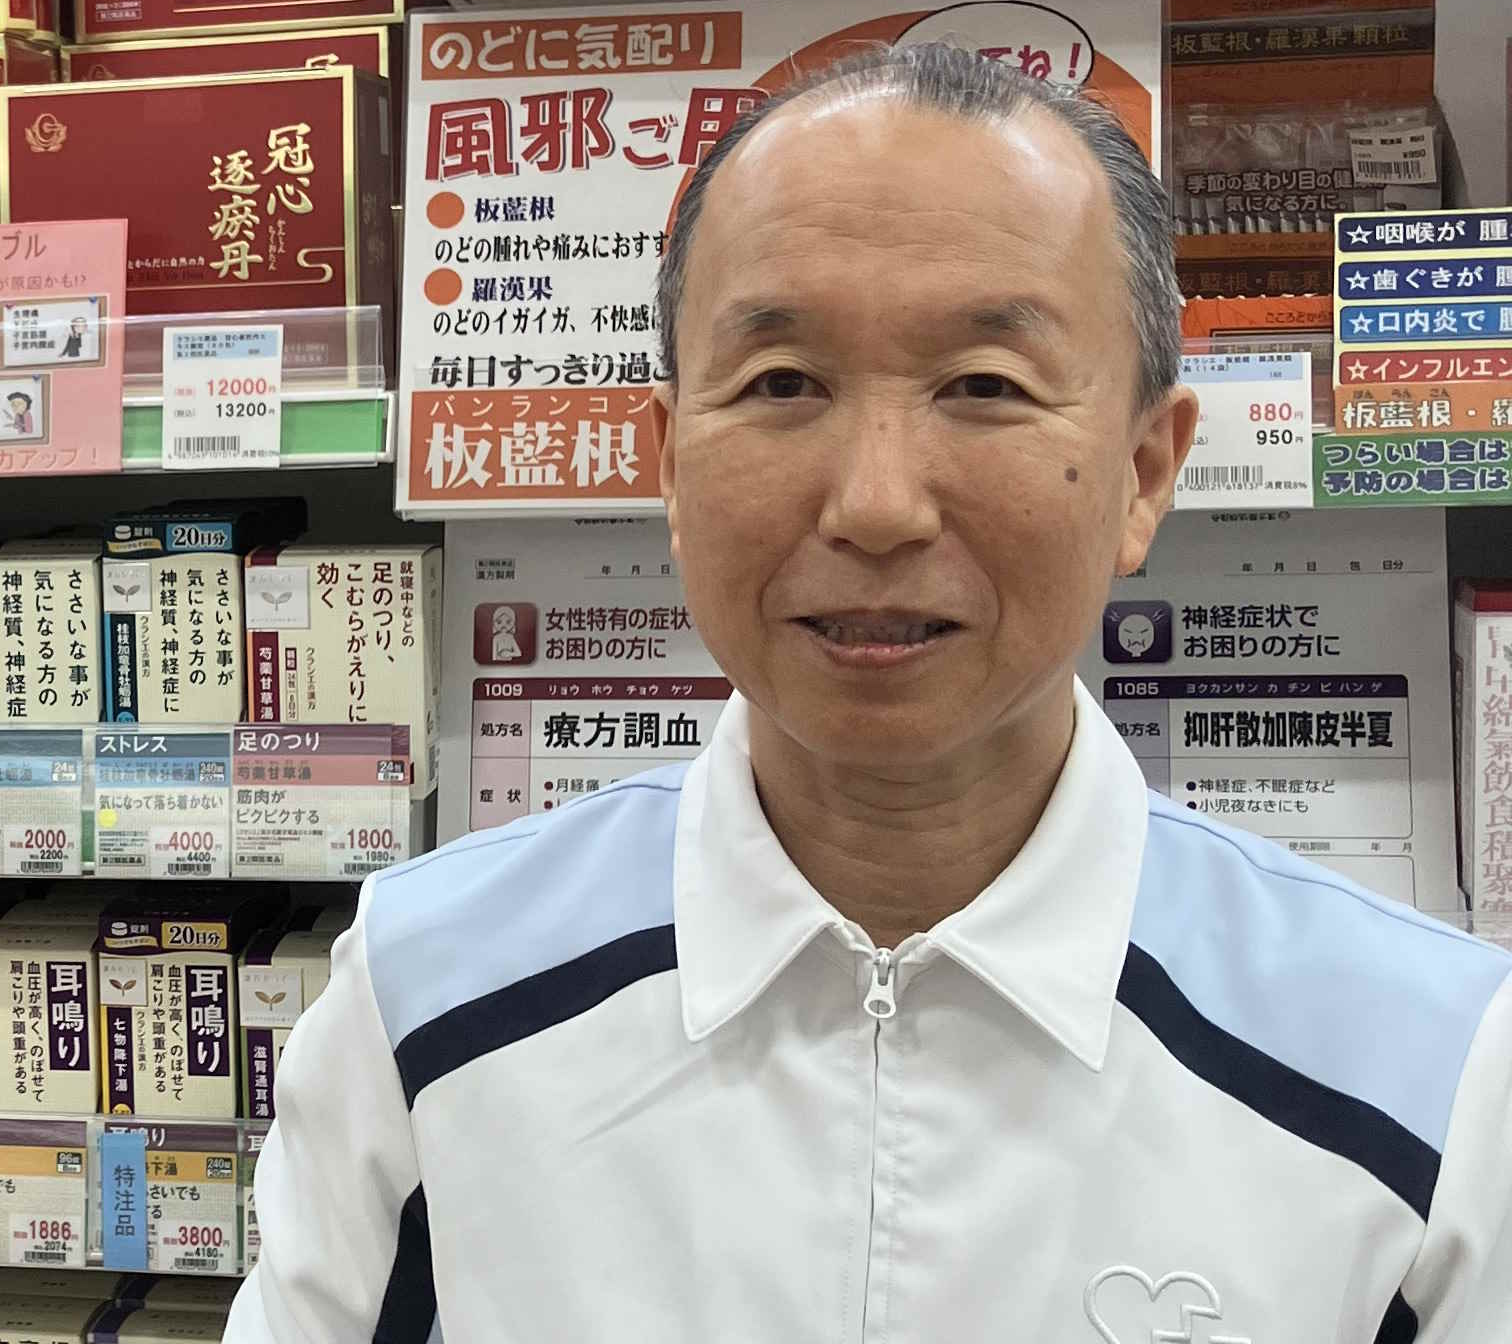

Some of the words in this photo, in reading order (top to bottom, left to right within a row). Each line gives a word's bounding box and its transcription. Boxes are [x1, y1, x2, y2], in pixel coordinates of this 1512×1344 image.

[430, 20, 713, 73] のどに気配り
[474, 195, 555, 223] 板藍根
[472, 275, 554, 301] 羅漢果
[1373, 267, 1483, 291] 歯ぐきが
[1378, 309, 1486, 333] 口内炎で
[430, 394, 650, 417] バンランコン
[424, 418, 640, 490] 板藍根
[172, 526, 226, 548] 20日分
[317, 563, 338, 610] 効く
[546, 607, 691, 631] 女性特有の症状
[1182, 605, 1319, 629] 神経症状で
[34, 569, 58, 708] 気になる方の
[67, 569, 91, 709] ささいな事が
[546, 637, 666, 660] お困りの方に
[1184, 635, 1340, 658] お困りの方に
[485, 684, 522, 696] 1009
[1117, 682, 1158, 695] 1085
[238, 730, 320, 752] 足のつり
[544, 712, 701, 748] 療方調血
[1184, 711, 1392, 748] 抑肝散加陳皮半夏
[1199, 800, 1309, 813] 小児夜なきにも
[170, 927, 222, 947] 20日分
[51, 963, 85, 1068] 耳鳴り
[190, 969, 225, 1072] 耳鳴り
[113, 1166, 136, 1237] 特注品
